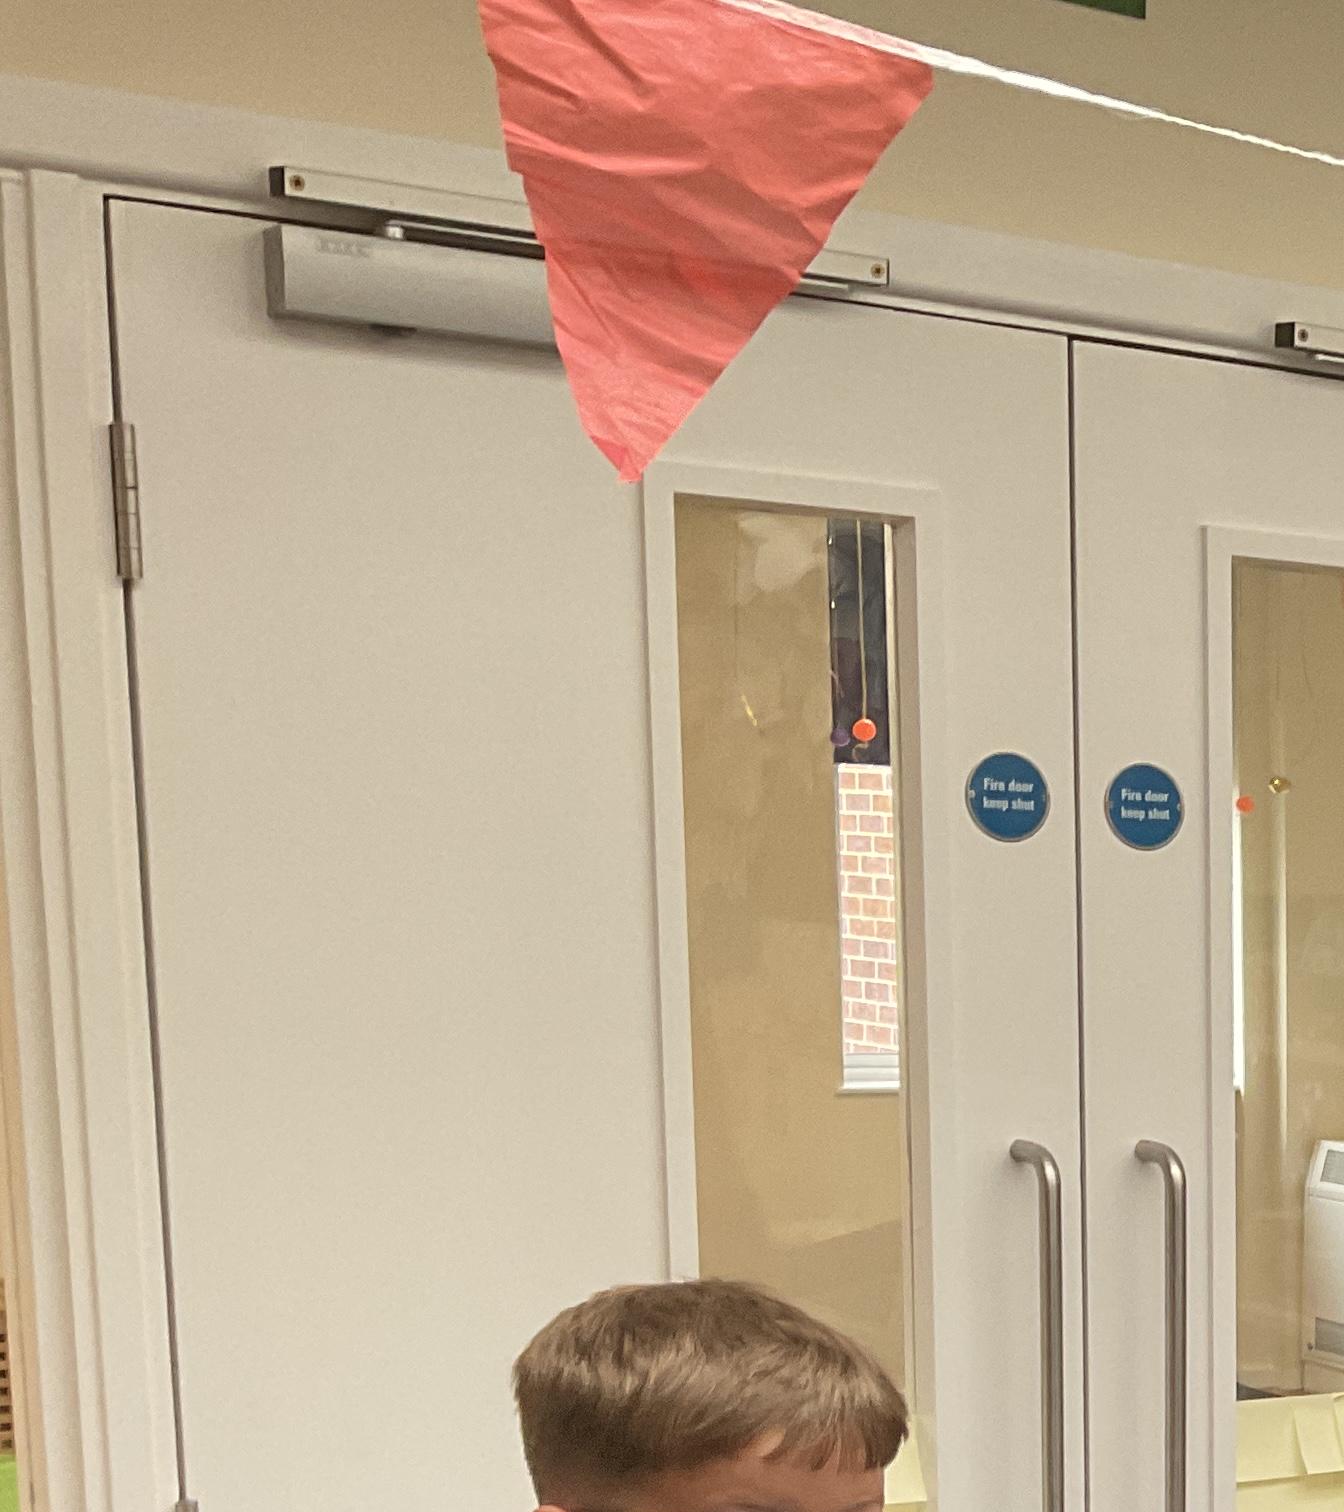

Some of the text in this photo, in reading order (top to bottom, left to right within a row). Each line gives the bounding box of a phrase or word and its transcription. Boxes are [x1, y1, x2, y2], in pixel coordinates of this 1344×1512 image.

[983, 778, 1034, 793] Fire door
[1121, 788, 1169, 803] Fire door
[983, 797, 1035, 812] keep shut
[1121, 806, 1170, 821] keep shut
